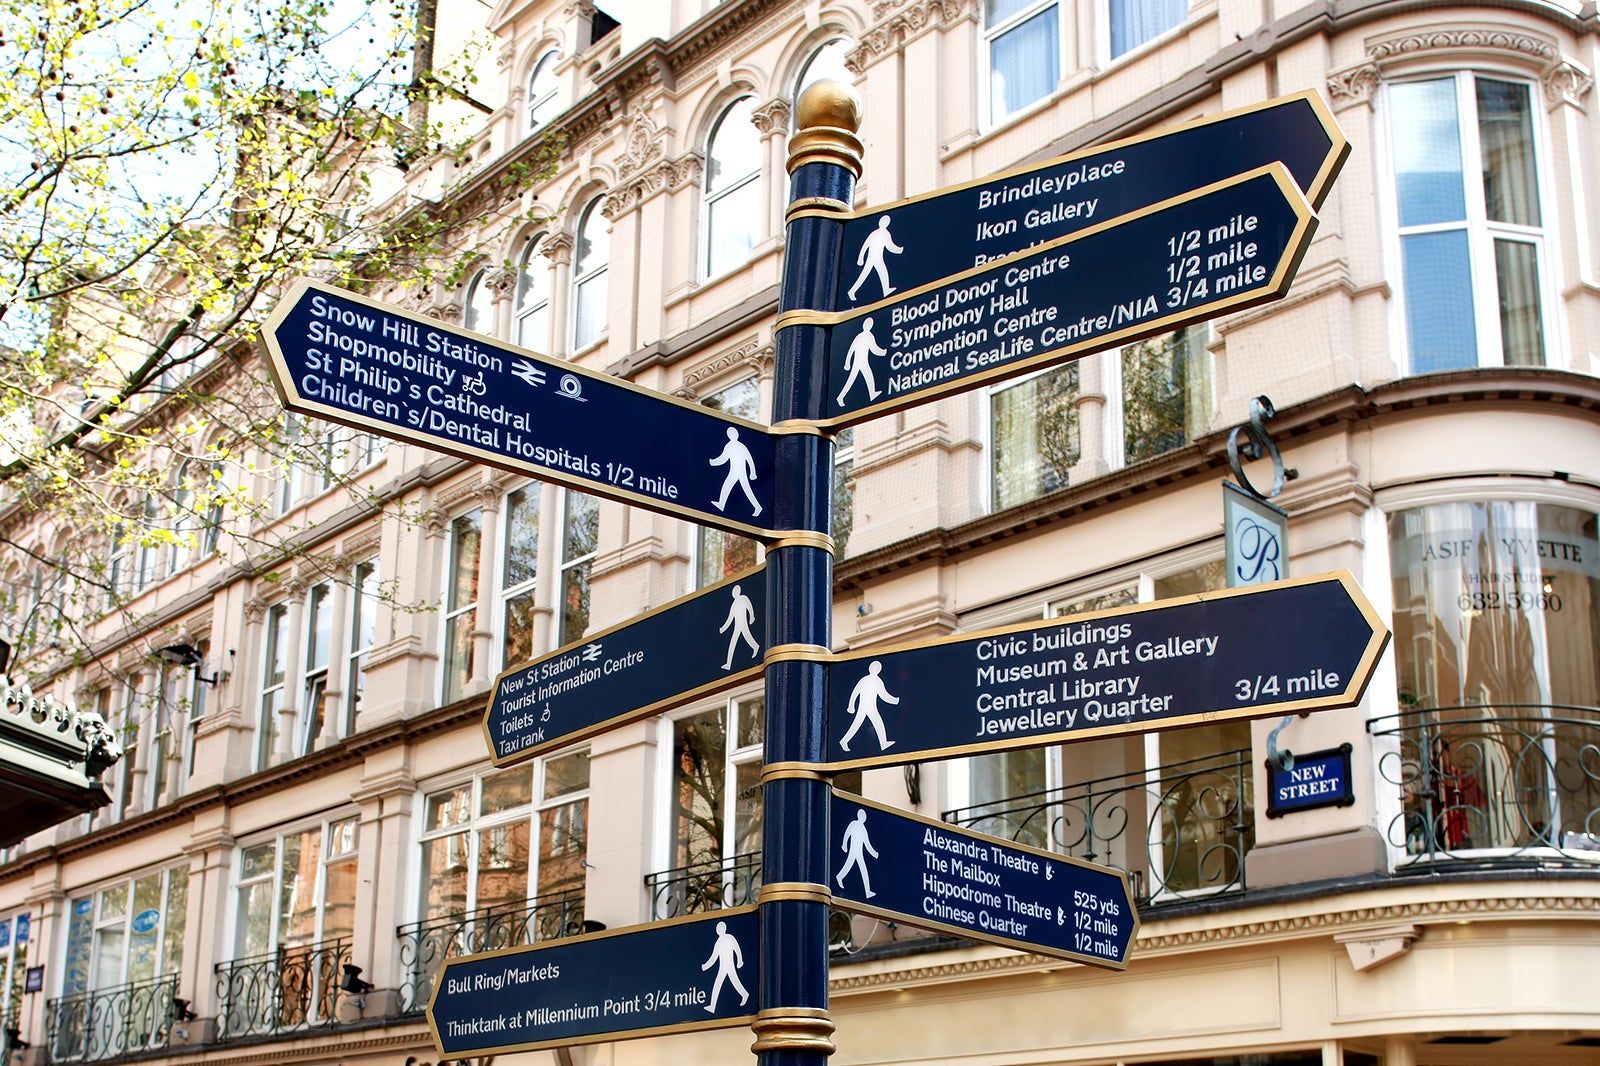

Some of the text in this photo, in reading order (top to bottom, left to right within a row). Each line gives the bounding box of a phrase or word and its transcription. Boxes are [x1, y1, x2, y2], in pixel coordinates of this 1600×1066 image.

[978, 160, 1125, 210] Brindleyplace
[976, 198, 1098, 241] Ikon Gallery
[891, 214, 1258, 327] Blood Donor Centre 1/2 mile
[890, 241, 1258, 348] Symphony Hall 1/2 mile
[310, 296, 503, 373] Snow Hill Station
[887, 264, 1266, 395] National SeaLife Centre/NIA 3/4 mile
[890, 305, 1058, 370] Convention Centre
[307, 321, 456, 385] Shopmobility
[305, 348, 333, 374] St
[427, 385, 531, 432] Cathedral
[506, 432, 600, 476] Hospitals
[606, 462, 634, 486] 1/2
[639, 476, 678, 498] mile
[1422, 538, 1582, 562] ASIF YVETTE
[1458, 593, 1561, 612] 632 5960
[976, 623, 1132, 661] Civic buildings
[976, 636, 1219, 687] Museum & Art Gallery
[501, 655, 579, 696] New St Station
[501, 651, 644, 715] Tourist Information Centre
[976, 675, 1140, 713] Central Library
[1234, 668, 1340, 700] 3/4 mile
[500, 713, 533, 736] Toilets
[976, 694, 1173, 737] Jewellery Quarter
[500, 728, 544, 755] Taxi rank
[1280, 778, 1339, 800] STREET
[1291, 764, 1326, 782] NEW
[924, 828, 1039, 874] Alexandra Theatre
[924, 850, 1000, 887] The Mailbox
[923, 872, 1118, 936] Hippodrome Theatre 1/2 mile
[1074, 890, 1119, 916] 525 yds
[923, 897, 1118, 958] Chinese Quarter 1/2 mile
[448, 964, 560, 994] Bull Ring/Markets
[447, 987, 706, 1037] Thinktank at Millennium Point 3/4 mile
